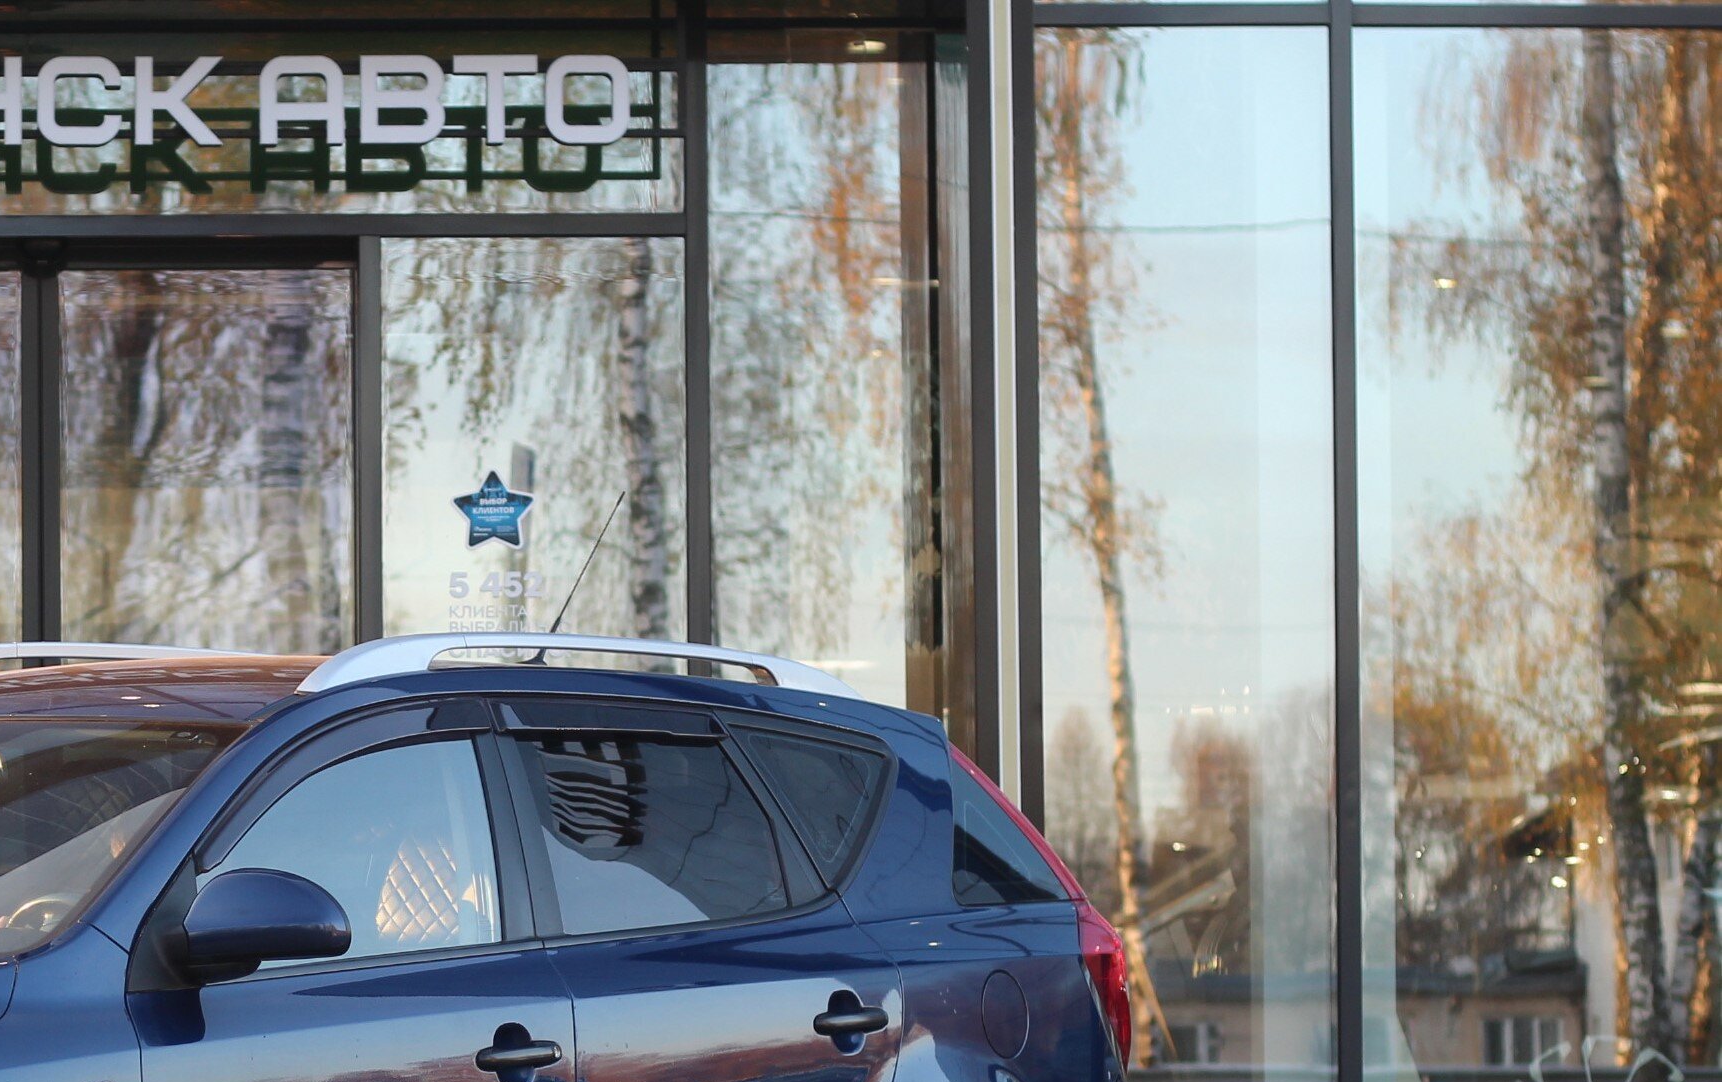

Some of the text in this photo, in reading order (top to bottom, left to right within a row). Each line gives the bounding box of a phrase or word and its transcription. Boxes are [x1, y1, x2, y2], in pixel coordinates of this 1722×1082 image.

[259, 54, 632, 146] АВТО
[479, 497, 508, 506] ВЫБОР
[472, 506, 515, 515] КЛИЕНТОВ
[448, 571, 545, 599] 5 452
[448, 605, 528, 619] КЛИЕНТА
